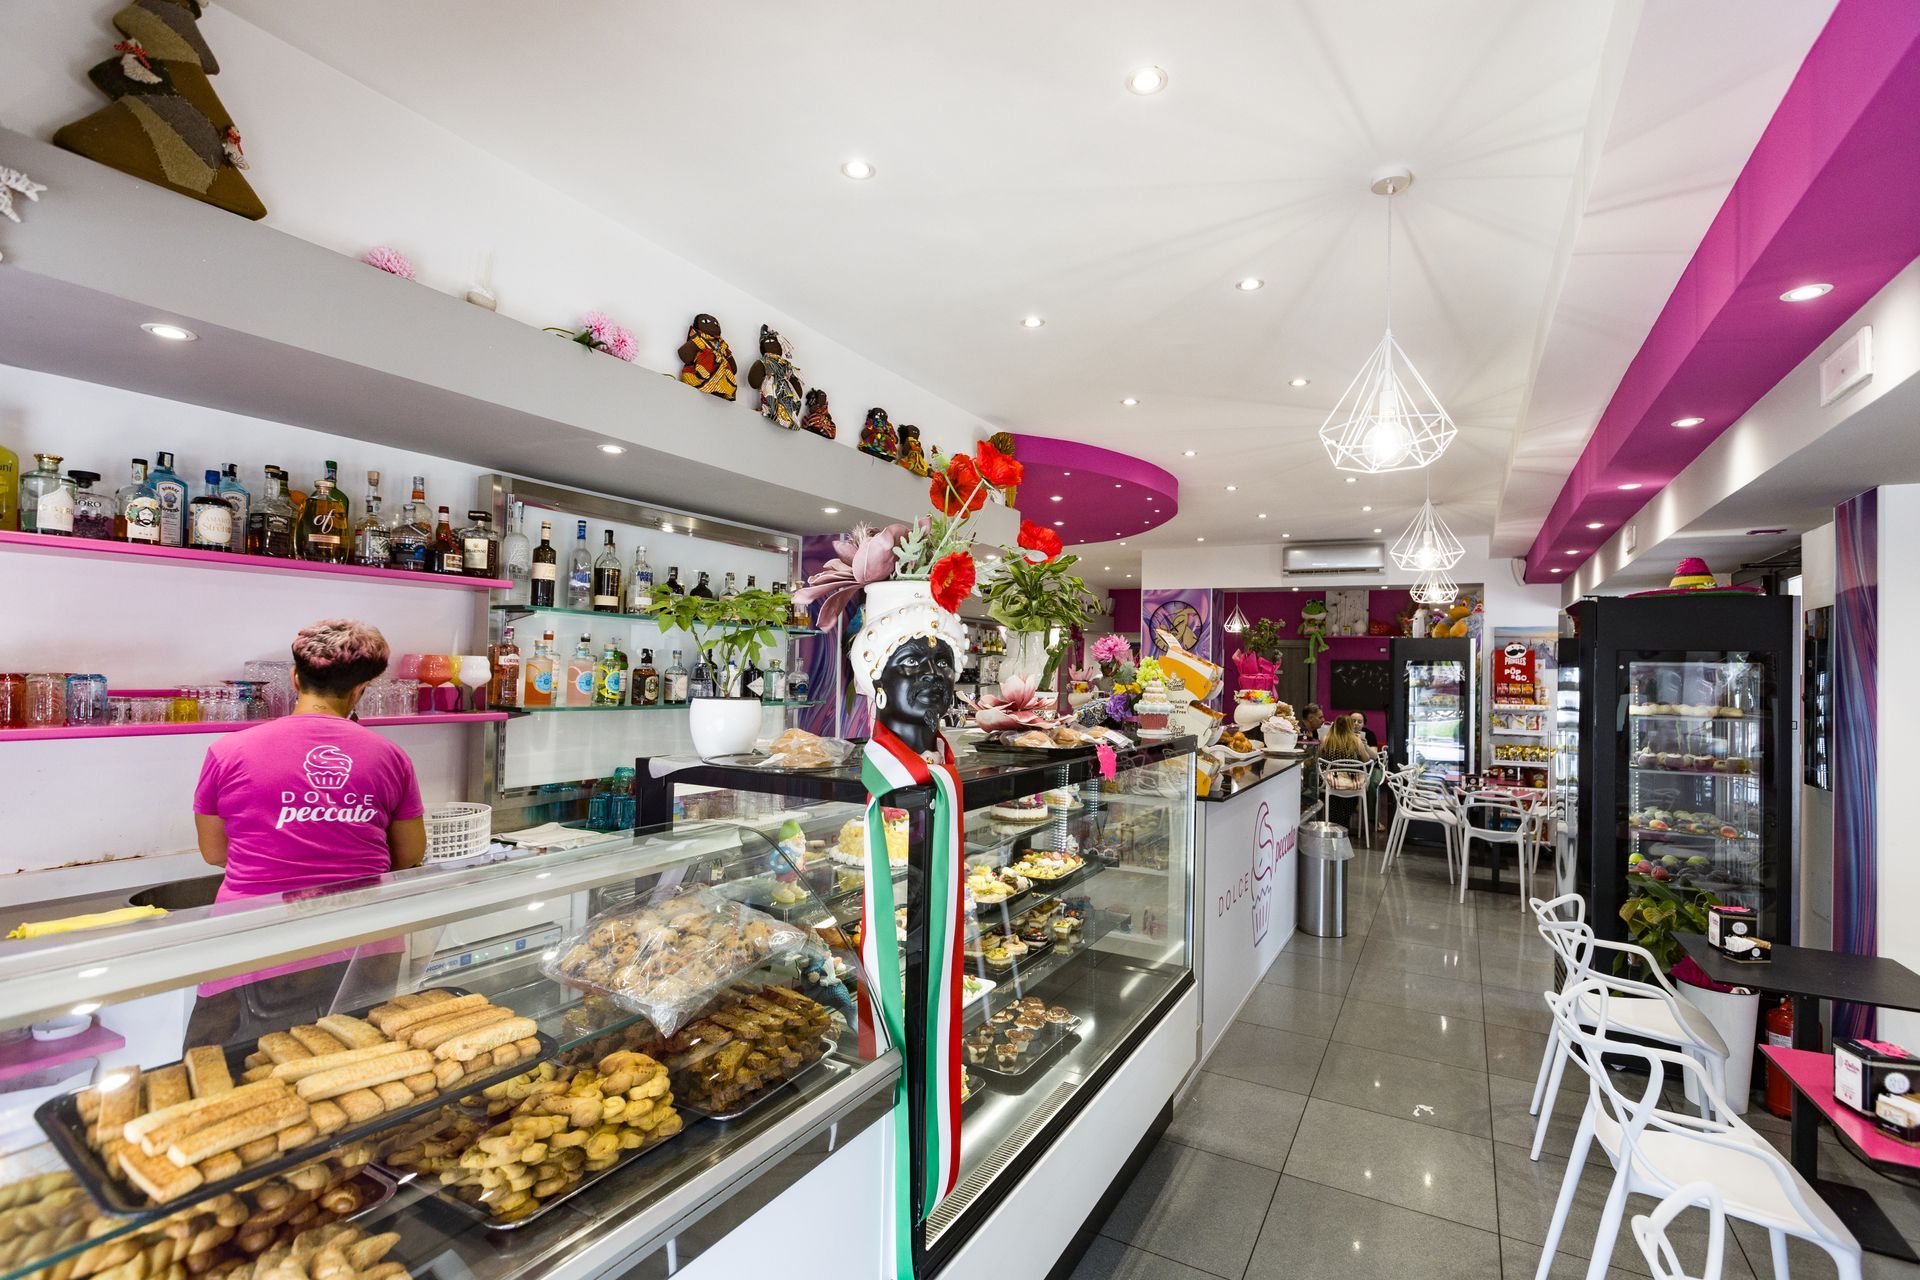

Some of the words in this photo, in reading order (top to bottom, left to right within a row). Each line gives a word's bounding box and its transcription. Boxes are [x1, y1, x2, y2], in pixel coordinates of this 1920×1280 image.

[1504, 656, 1526, 666] PRINGLES
[281, 791, 375, 806] DOLCE
[275, 804, 378, 830] peccato
[1218, 872, 1249, 918] DOLCE
